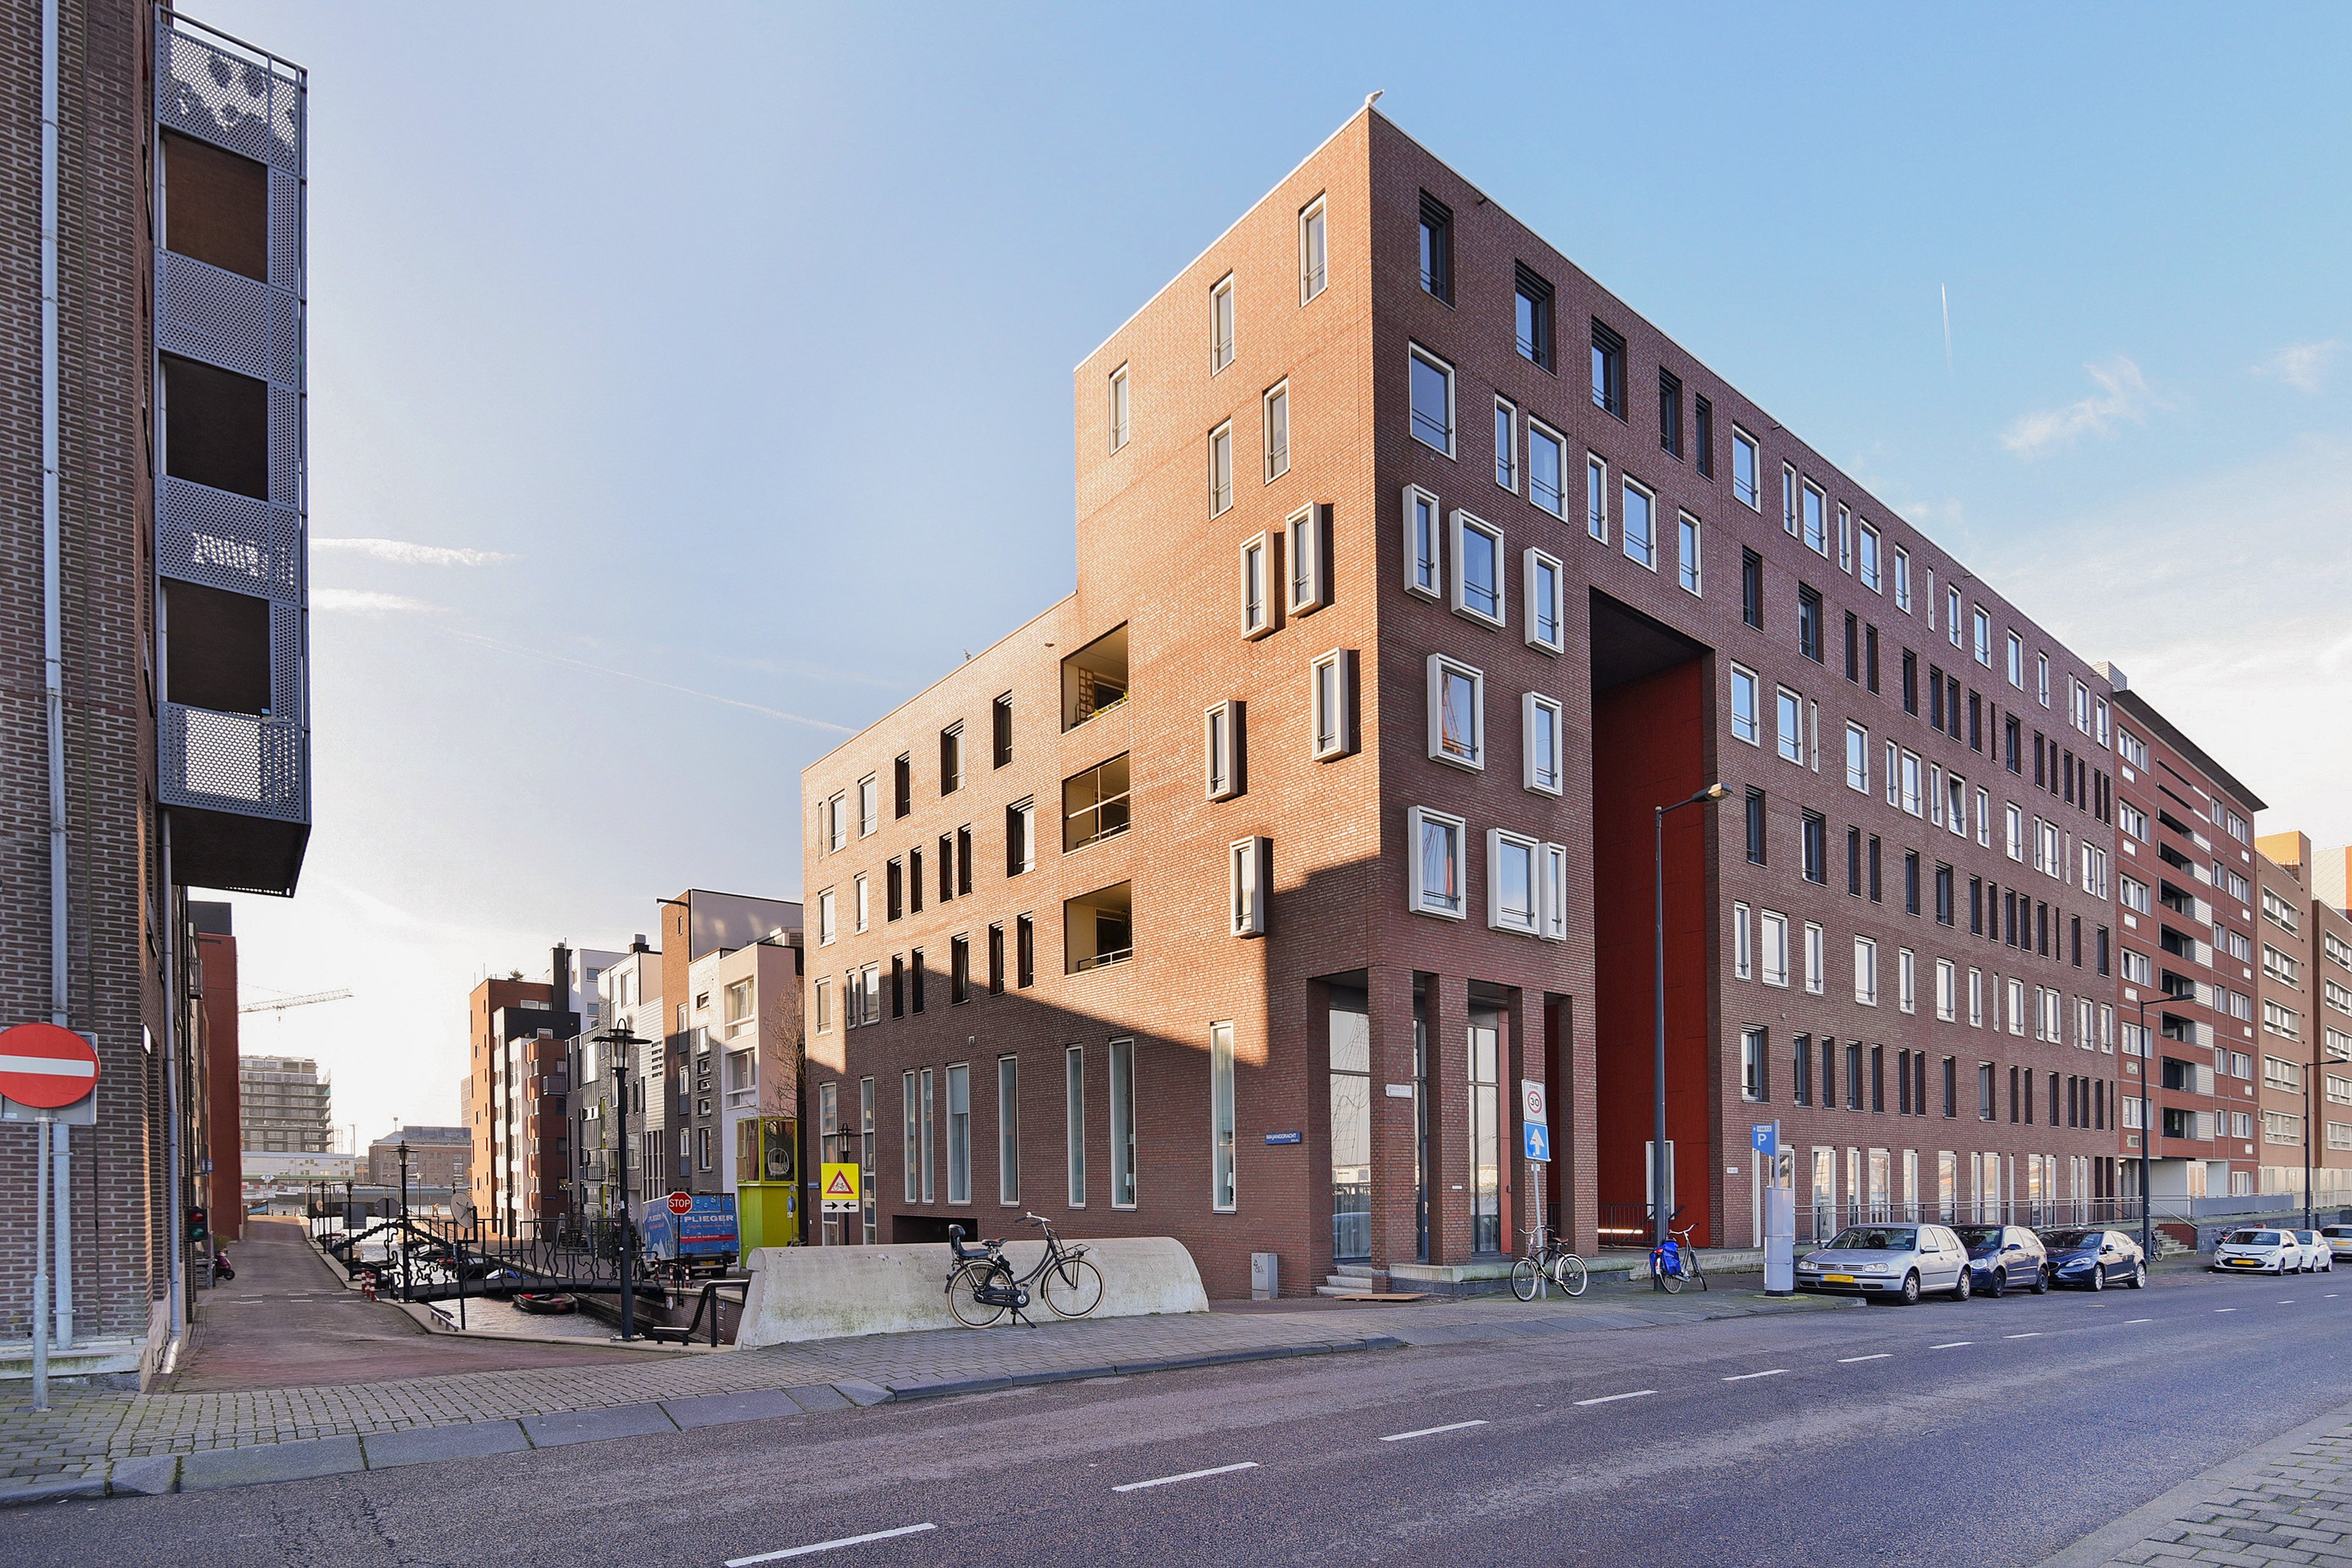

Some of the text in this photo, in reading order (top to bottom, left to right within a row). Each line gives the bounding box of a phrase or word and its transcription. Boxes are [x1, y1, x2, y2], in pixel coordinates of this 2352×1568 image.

[1530, 1097, 1539, 1107] 30
[1758, 1134, 1767, 1146] P
[669, 1199, 691, 1208] STOP
